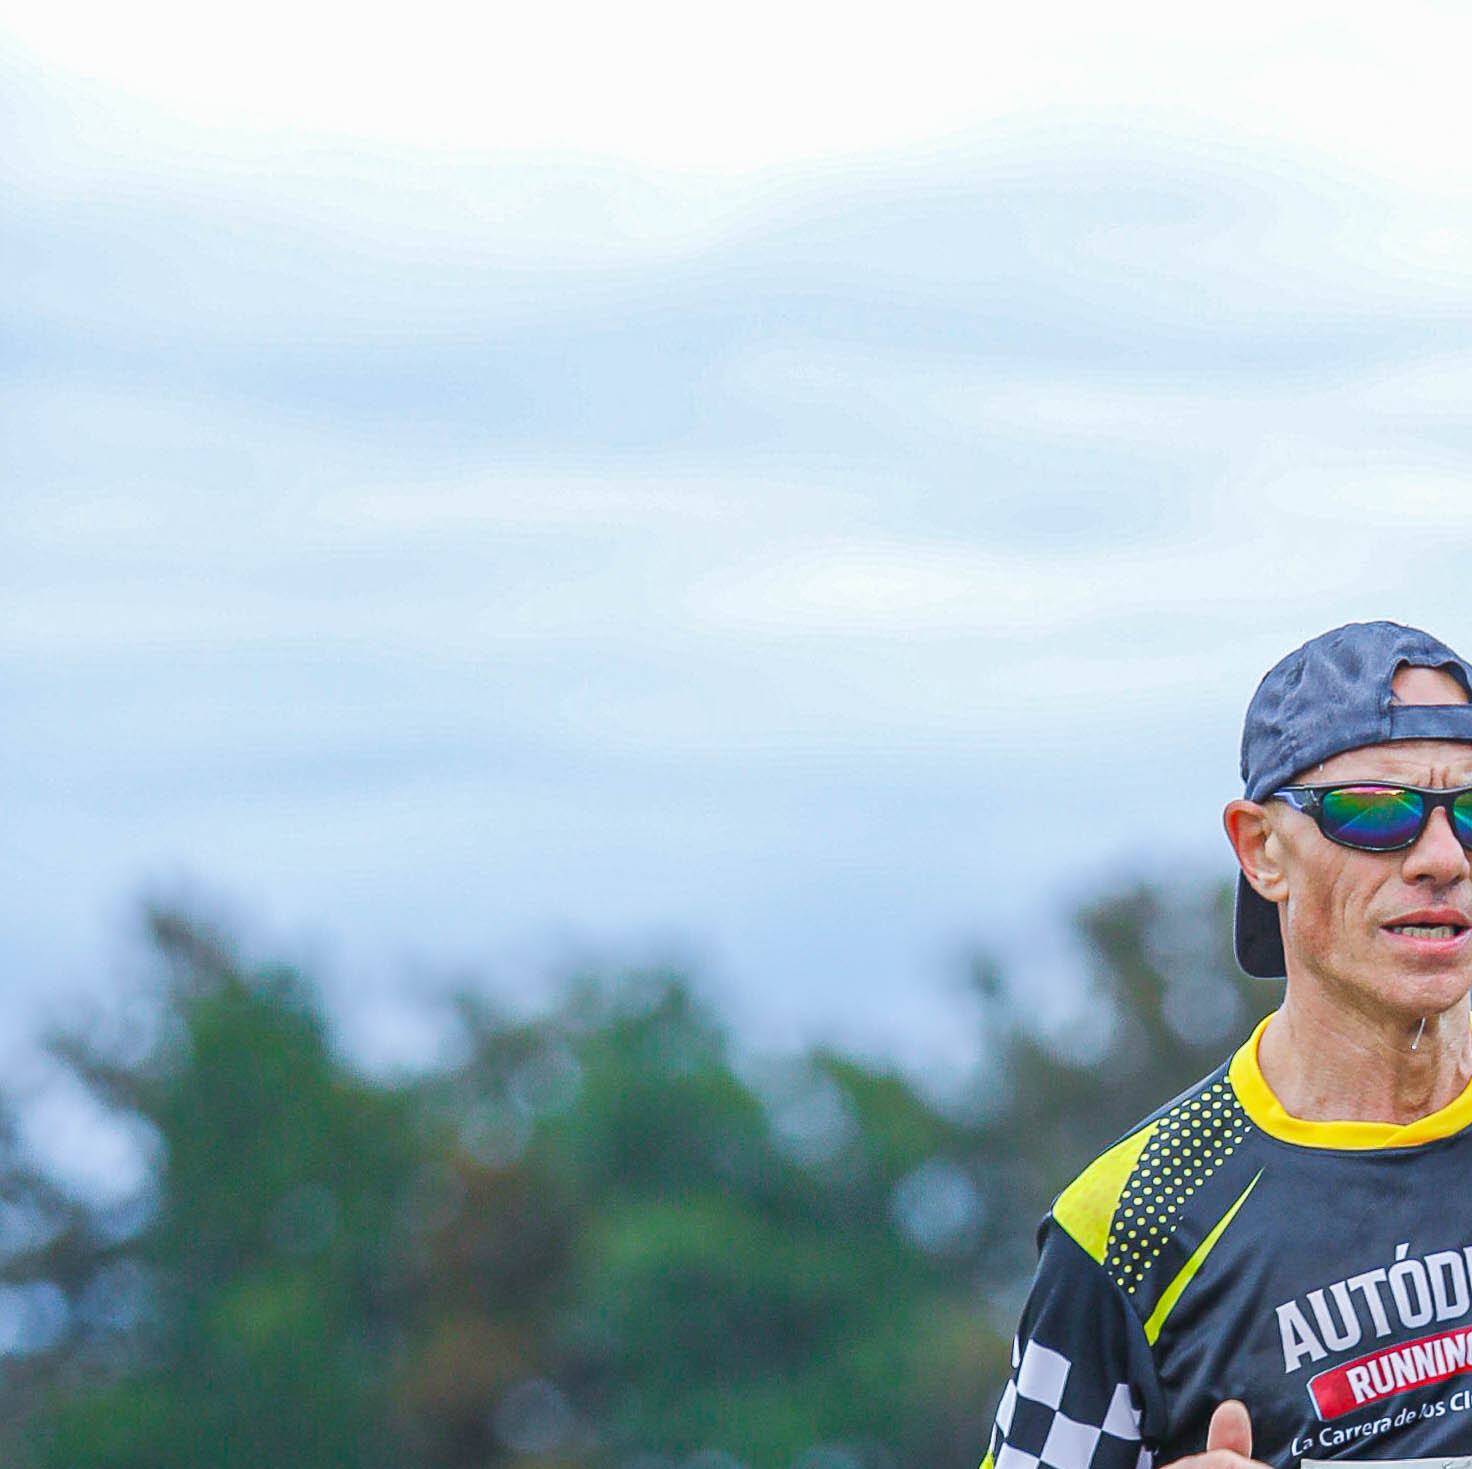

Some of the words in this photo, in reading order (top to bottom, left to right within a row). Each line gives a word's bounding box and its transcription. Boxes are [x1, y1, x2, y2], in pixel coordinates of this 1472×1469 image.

[1291, 1437, 1314, 1457] La
[1319, 1417, 1392, 1447] Carrera
[1394, 1408, 1416, 1427] de
[1418, 1401, 1446, 1420] los
